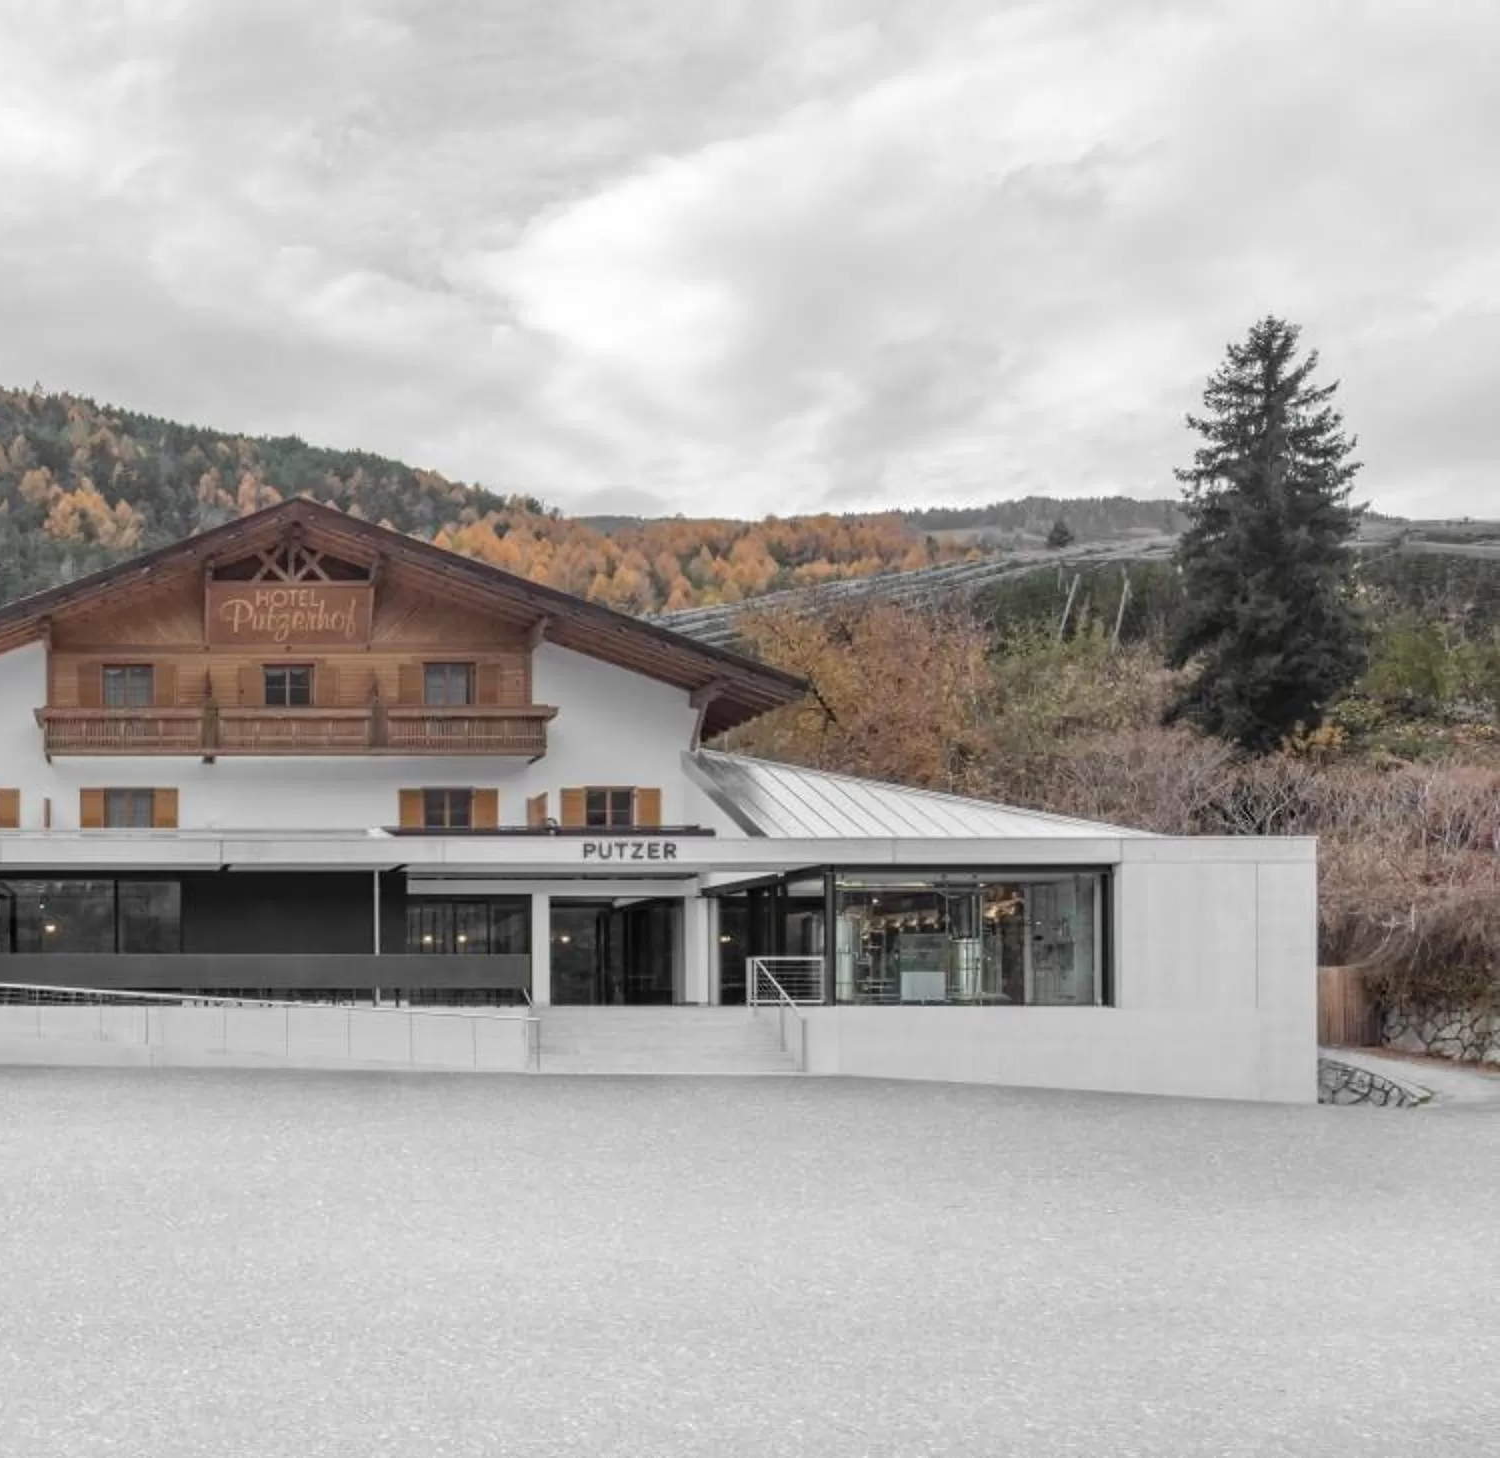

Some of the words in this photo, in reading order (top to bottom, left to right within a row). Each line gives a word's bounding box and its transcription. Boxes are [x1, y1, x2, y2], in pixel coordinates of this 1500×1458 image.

[255, 589, 321, 608] HOTEL
[219, 597, 357, 642] Putzerhof
[582, 843, 677, 860] PUTZER
